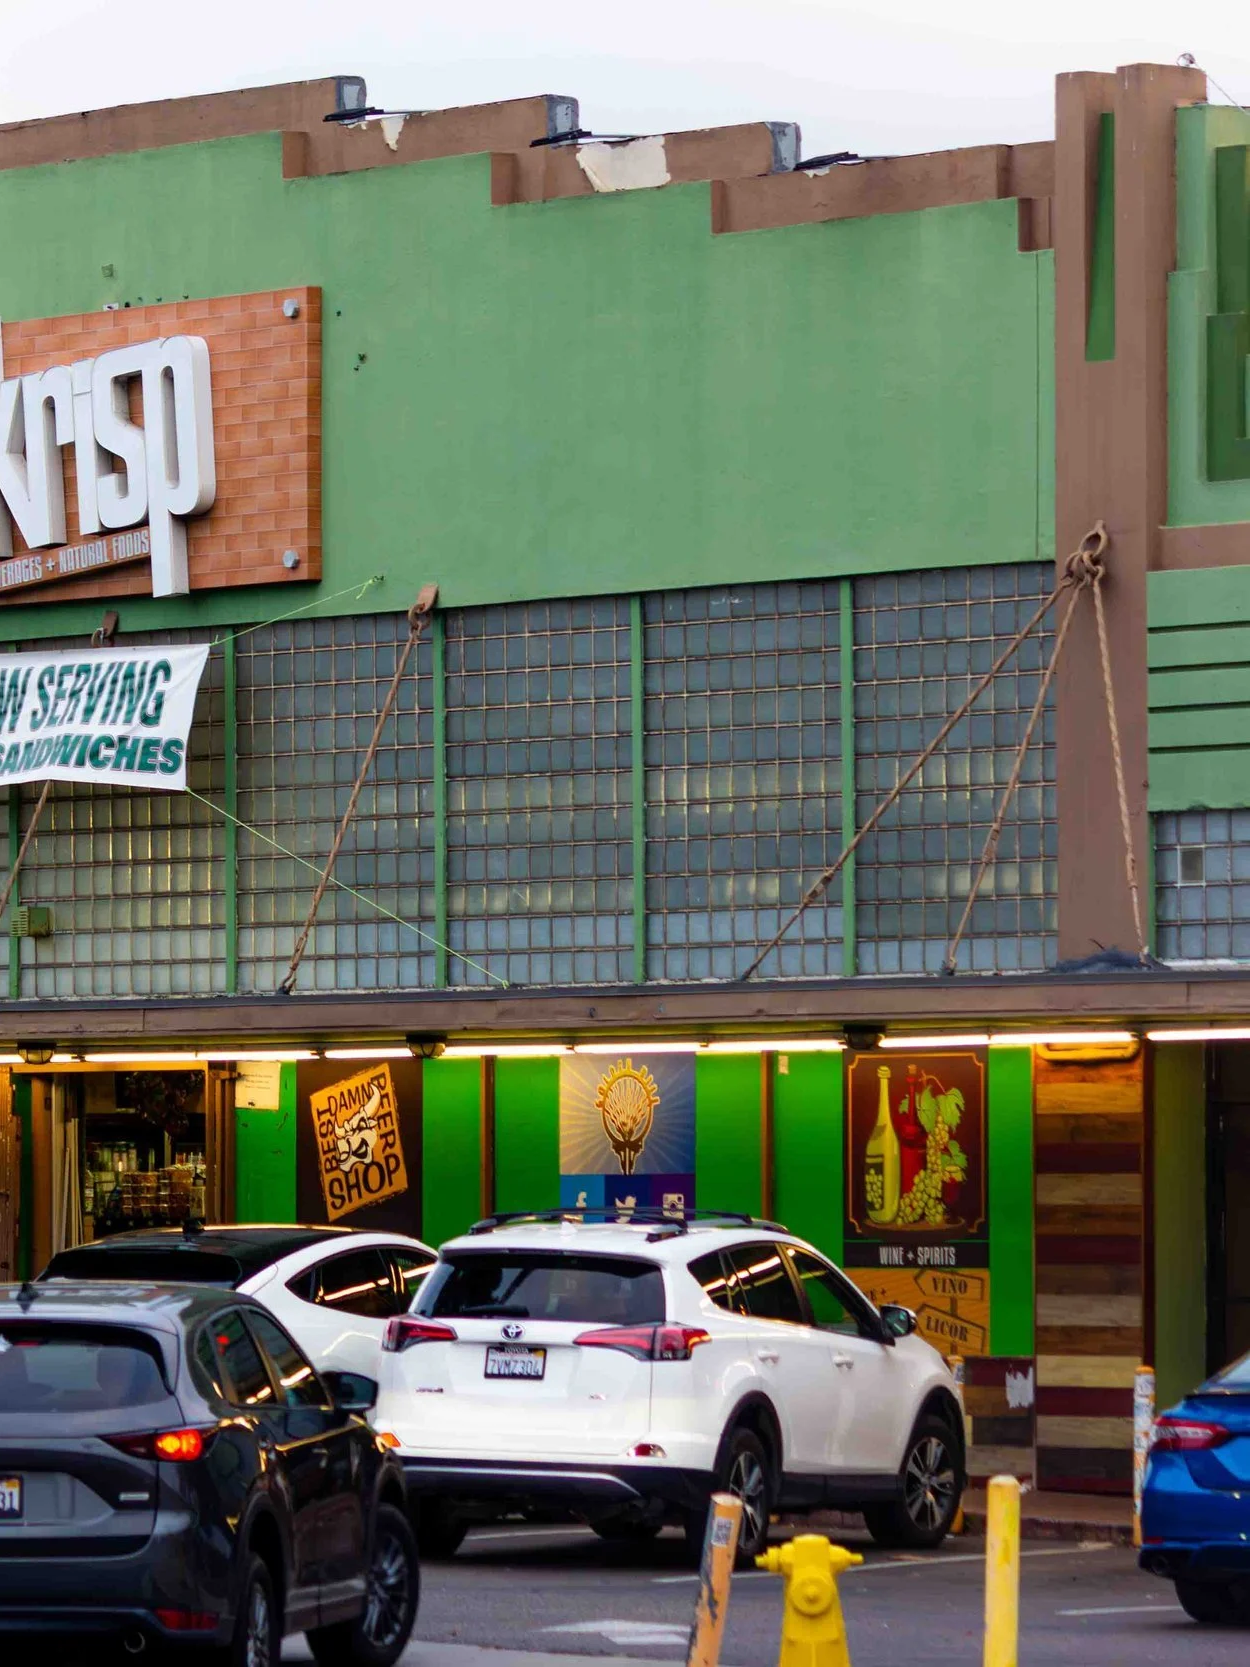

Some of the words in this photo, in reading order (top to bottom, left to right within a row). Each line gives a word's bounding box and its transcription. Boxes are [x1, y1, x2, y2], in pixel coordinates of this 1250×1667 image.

[59, 540, 110, 574] NATURAL
[112, 529, 149, 561] FOODS
[30, 659, 171, 732] SERVING
[316, 1106, 340, 1174] BEST
[328, 1152, 400, 1211] SHOP
[879, 1246, 904, 1265] WINE
[917, 1246, 956, 1265] SPIRITS
[931, 1276, 968, 1294] VINO
[925, 1315, 968, 1342] LICOR
